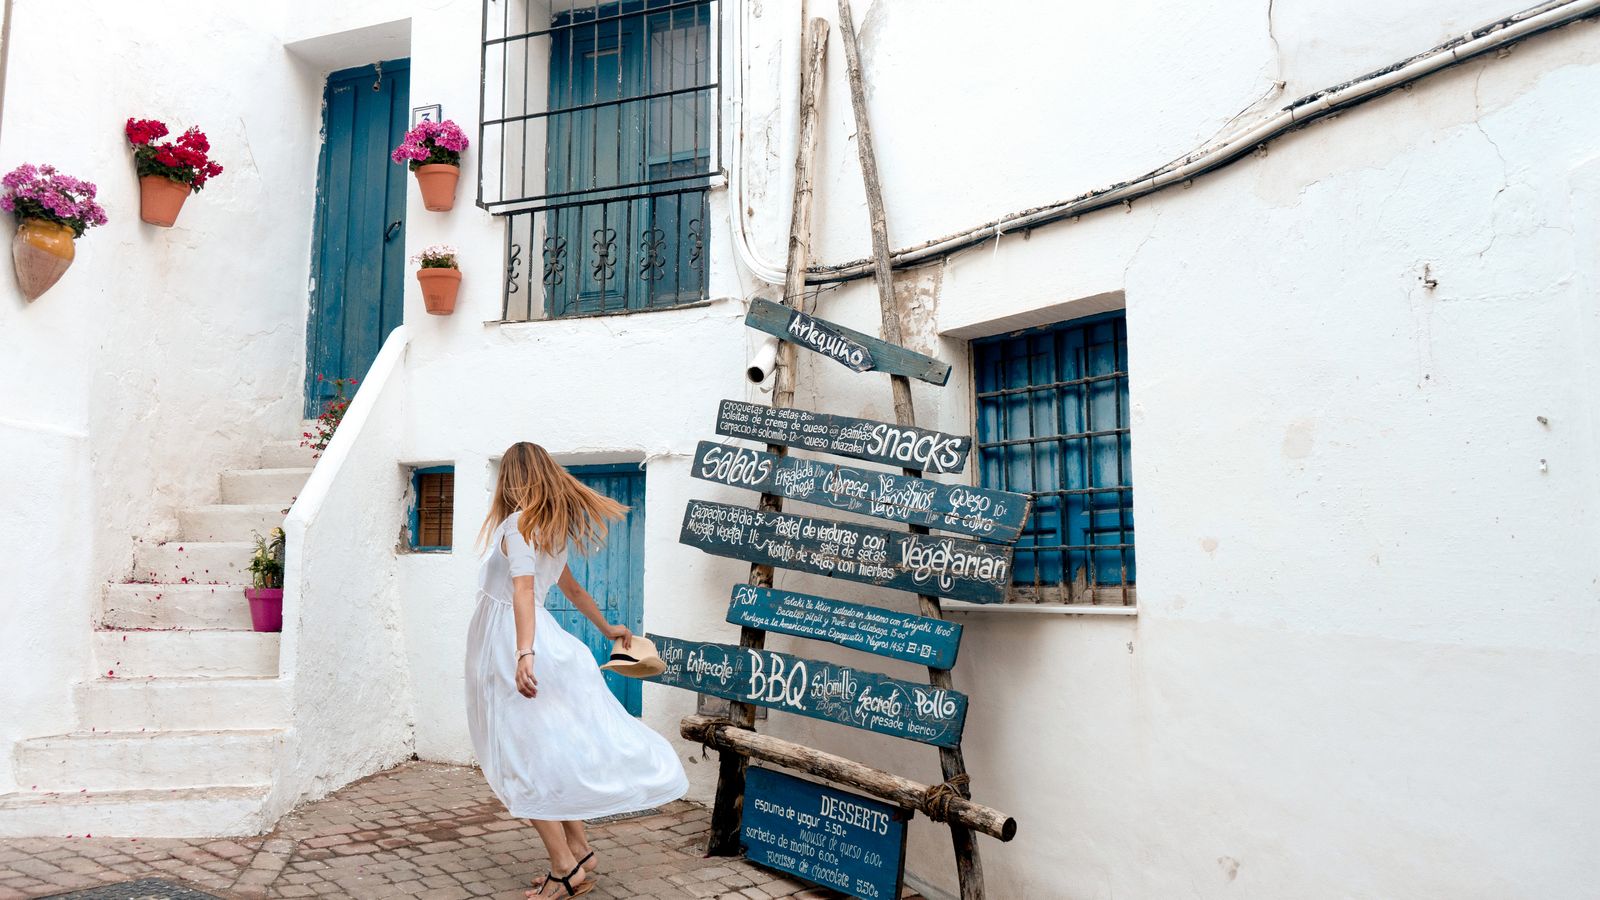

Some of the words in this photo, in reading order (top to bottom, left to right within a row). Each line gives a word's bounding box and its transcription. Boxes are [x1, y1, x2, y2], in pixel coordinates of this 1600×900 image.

[789, 314, 864, 366] Arlequino
[722, 410, 749, 422] bolsitas
[752, 414, 762, 425] de
[765, 418, 787, 429] crema
[791, 420, 800, 430] de
[838, 426, 872, 441] gambas
[766, 407, 776, 417] de
[720, 421, 751, 434] carpaccio
[758, 427, 787, 441] solomillo
[702, 447, 772, 485] Salads
[775, 460, 813, 486] Ensalada
[823, 471, 869, 501] Caprese
[944, 507, 960, 524] de
[776, 516, 803, 539] Pastel
[803, 519, 816, 537] de
[817, 523, 858, 545] verduras
[862, 535, 885, 550] con
[767, 540, 794, 562] Risotto
[796, 544, 808, 562] de
[810, 552, 835, 570] setas
[838, 559, 855, 574] con
[859, 561, 895, 579] hierbas
[820, 541, 839, 556] salsa
[841, 544, 854, 558] de
[857, 548, 887, 562] setas
[902, 536, 1007, 589] Vegetarian
[814, 628, 826, 637] con
[822, 617, 829, 627] y
[848, 620, 857, 629] de
[889, 618, 901, 626] con
[686, 650, 733, 685] Entrecote
[811, 669, 857, 700] Solomillo
[914, 689, 956, 719] Pollo
[754, 798, 785, 817] espuma
[786, 806, 795, 820] de
[797, 811, 820, 829] yogur
[820, 795, 889, 836] DESSERTS
[746, 826, 775, 844] sorbete
[778, 833, 788, 848] de
[790, 838, 815, 857] mojito
[800, 829, 827, 848] mousse
[828, 835, 838, 851] de
[840, 842, 862, 860] queso
[798, 859, 809, 873] de
[812, 863, 850, 888] chocolate
